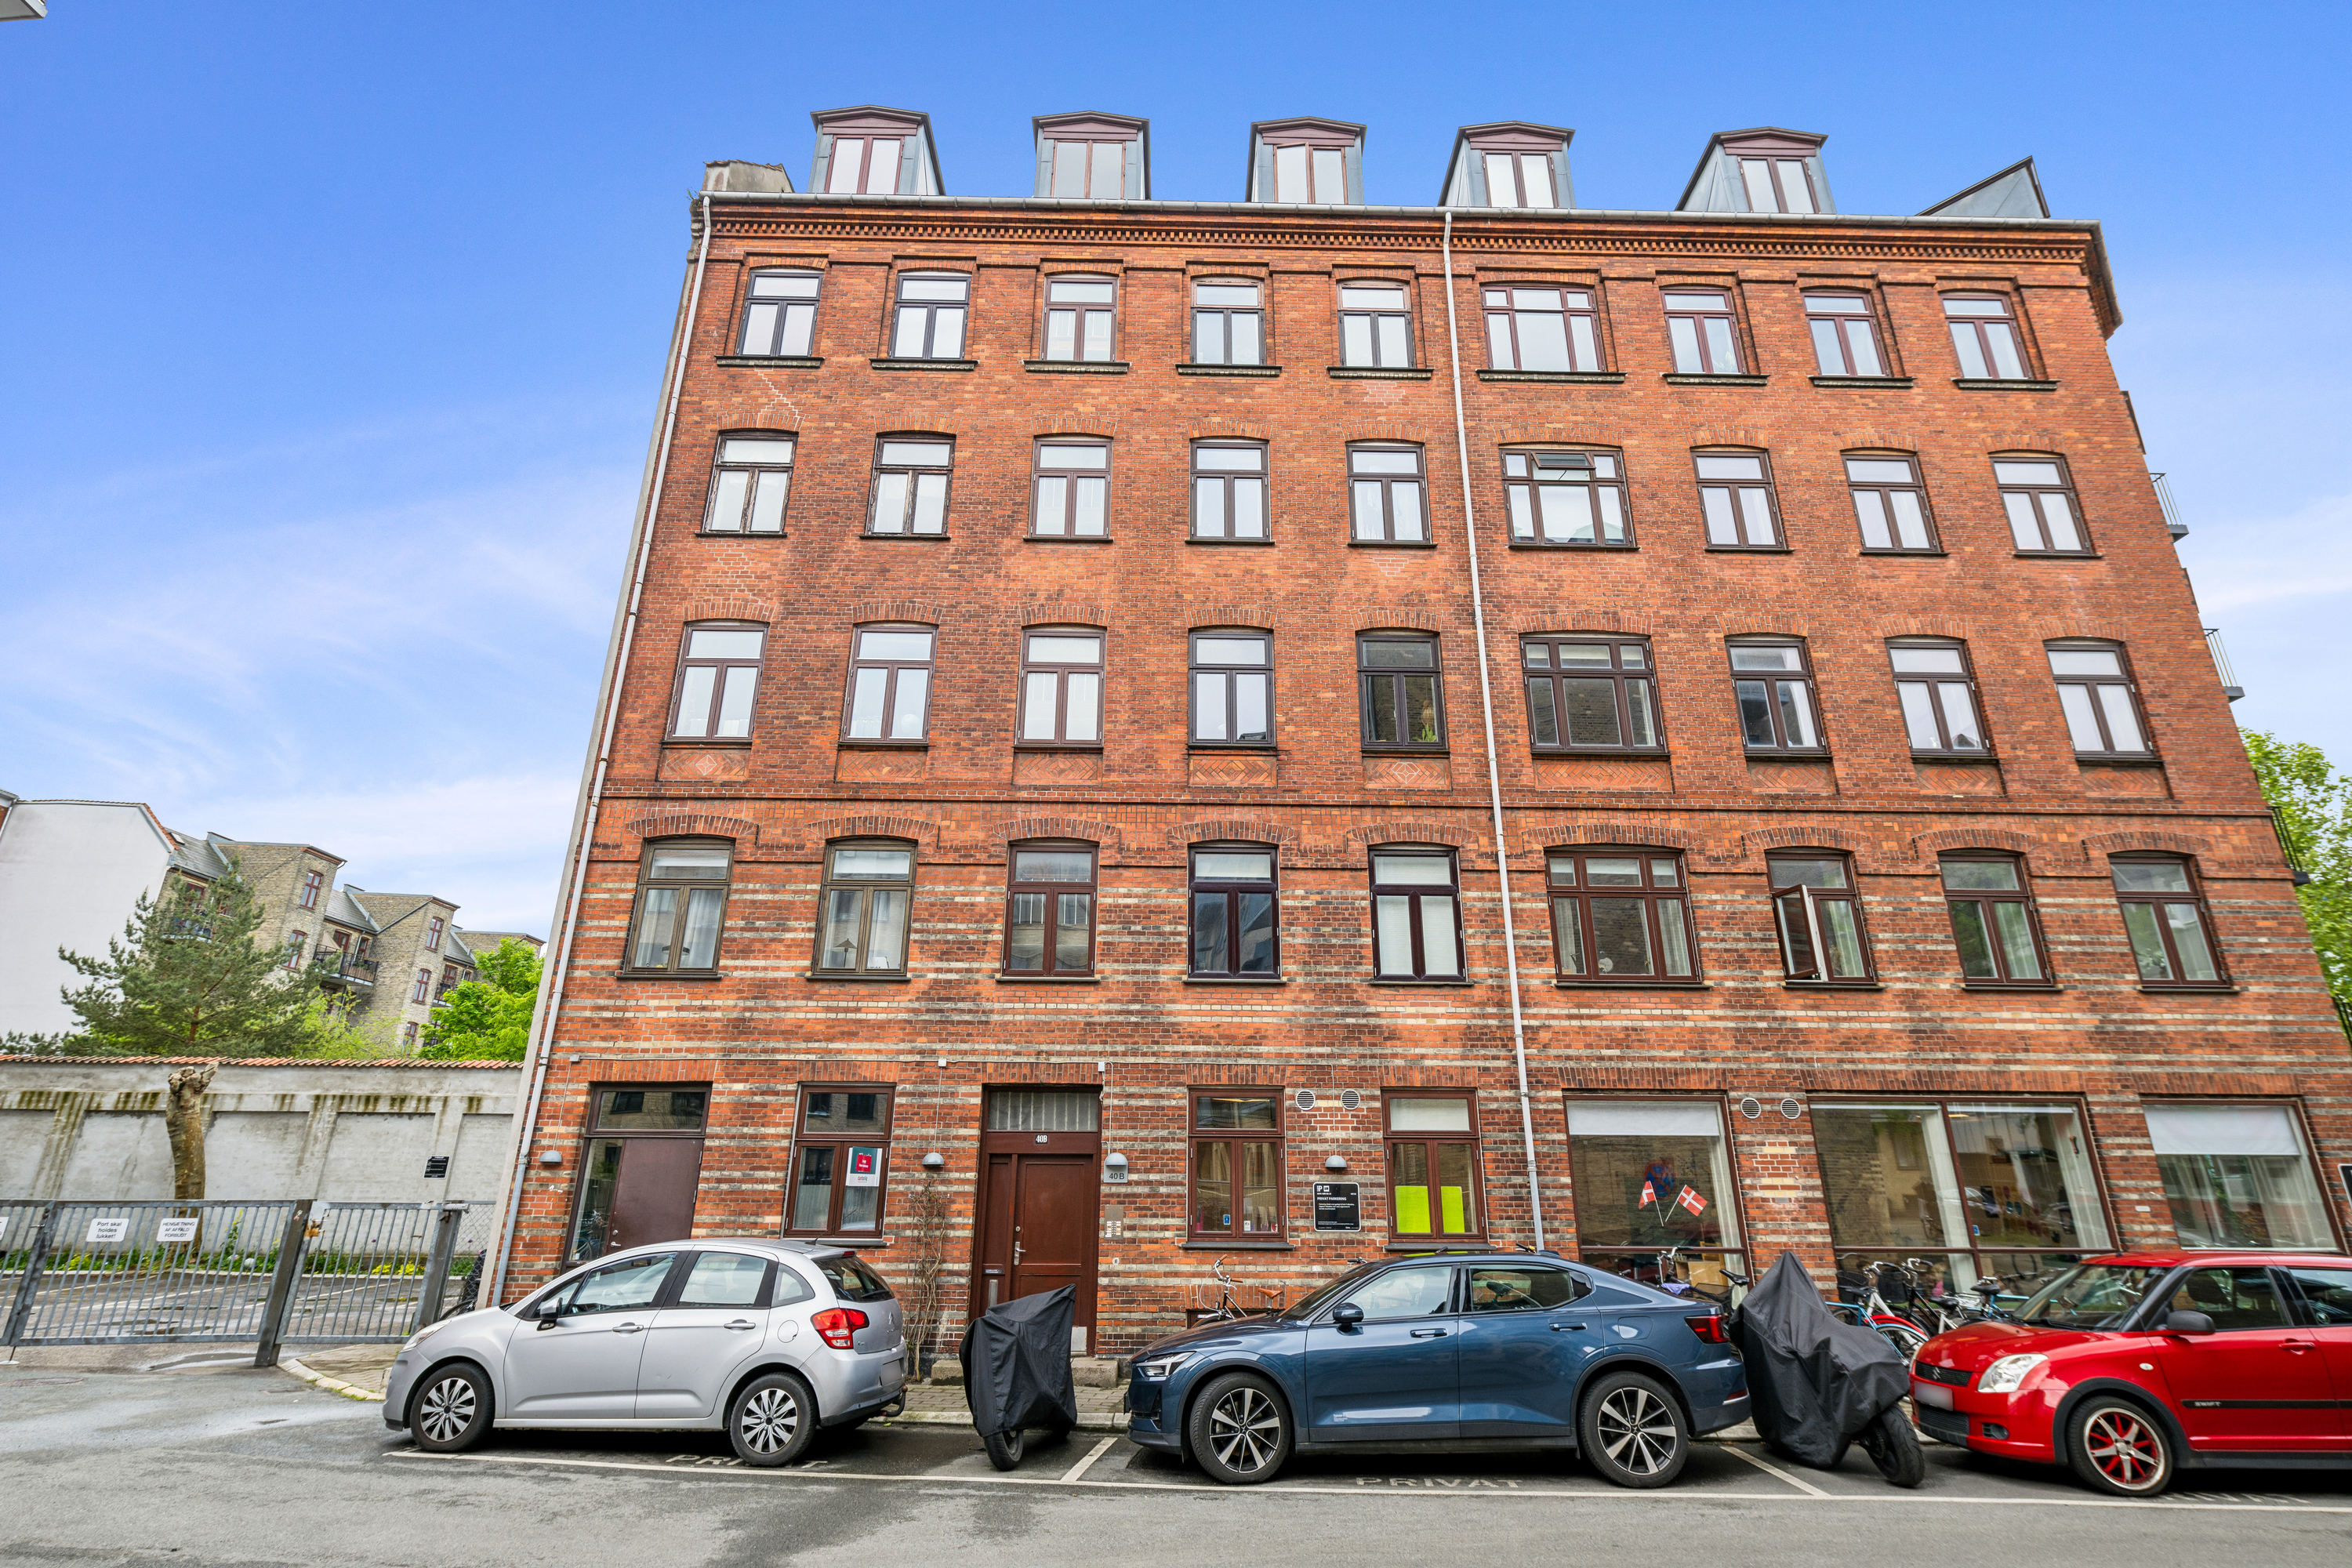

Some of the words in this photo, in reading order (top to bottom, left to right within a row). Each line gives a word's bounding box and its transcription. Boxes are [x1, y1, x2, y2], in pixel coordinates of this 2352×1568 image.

[1036, 1134, 1047, 1143] 40B
[666, 1454, 828, 1468] PRIT
[1356, 1477, 1523, 1488] PRIVAT
